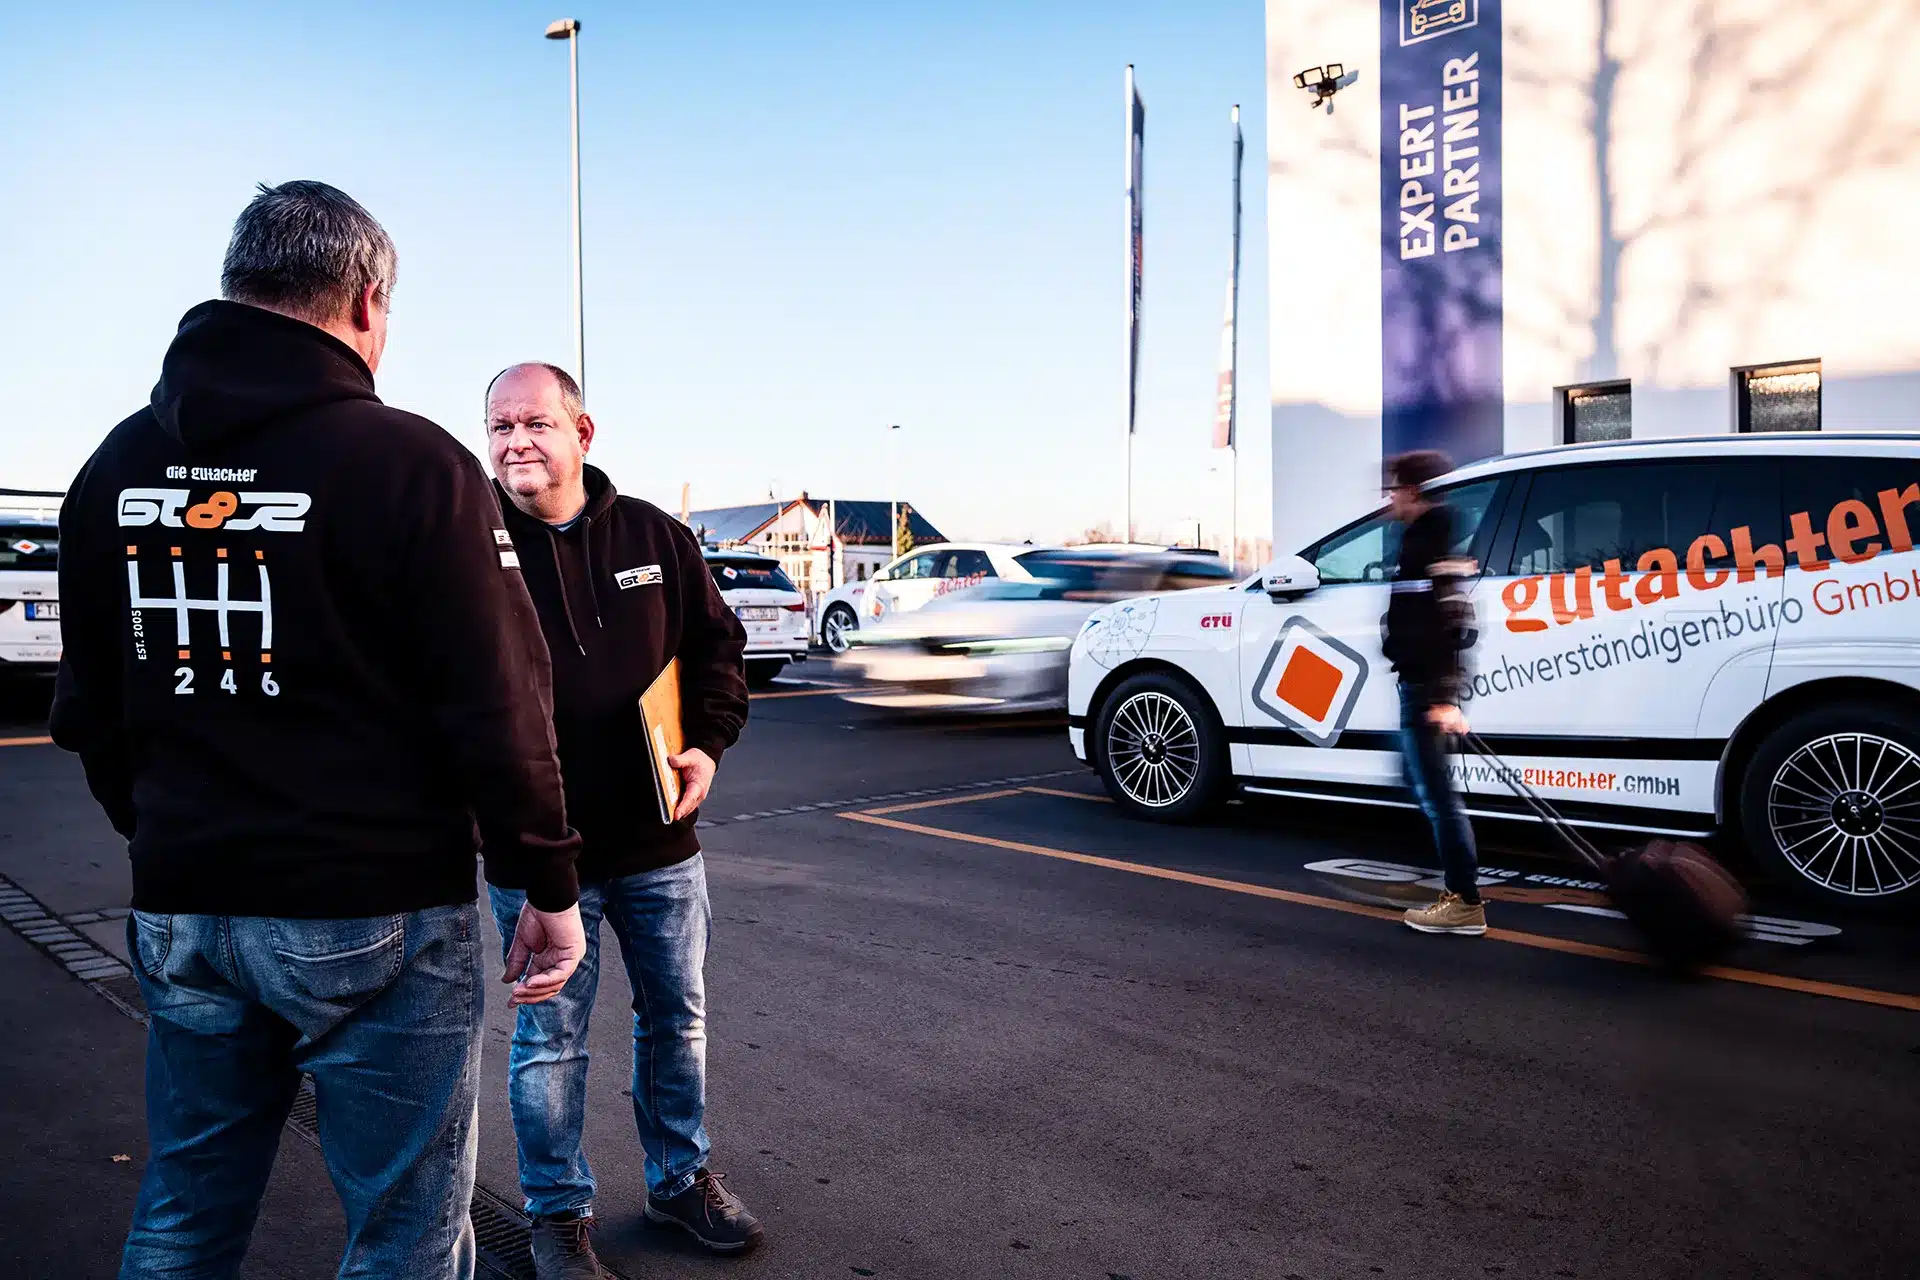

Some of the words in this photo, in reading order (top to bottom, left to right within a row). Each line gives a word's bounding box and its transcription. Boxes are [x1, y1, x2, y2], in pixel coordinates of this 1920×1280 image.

[1443, 51, 1479, 252] PARTNER
[1400, 103, 1435, 260] EXPERT
[166, 465, 187, 479] die
[191, 466, 257, 482] gutachter
[1501, 483, 1920, 633] gutachter
[131, 610, 144, 637] 2005
[136, 639, 147, 660] EST.
[174, 667, 194, 694] 2
[220, 669, 238, 694] 4
[261, 671, 280, 696] 6
